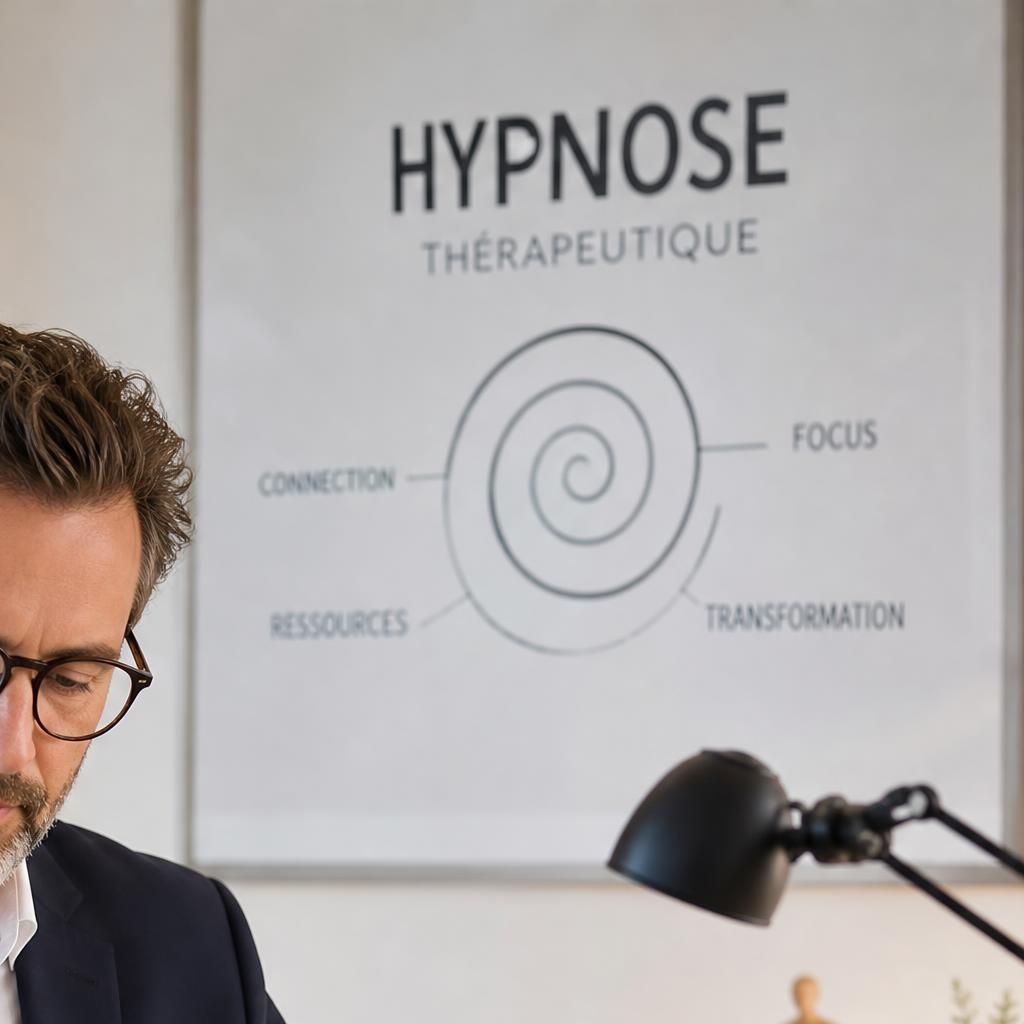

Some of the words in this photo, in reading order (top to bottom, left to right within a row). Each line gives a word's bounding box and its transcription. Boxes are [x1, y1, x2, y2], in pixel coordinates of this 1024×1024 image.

[393, 91, 789, 213] HYPNOSE
[422, 219, 759, 276] THÉRAPEUTIQUE
[793, 421, 878, 452] FOCUS
[258, 467, 396, 497] CONNECTION
[271, 610, 409, 640] RESSOURCES
[706, 602, 905, 633] TRANSFORMATION
